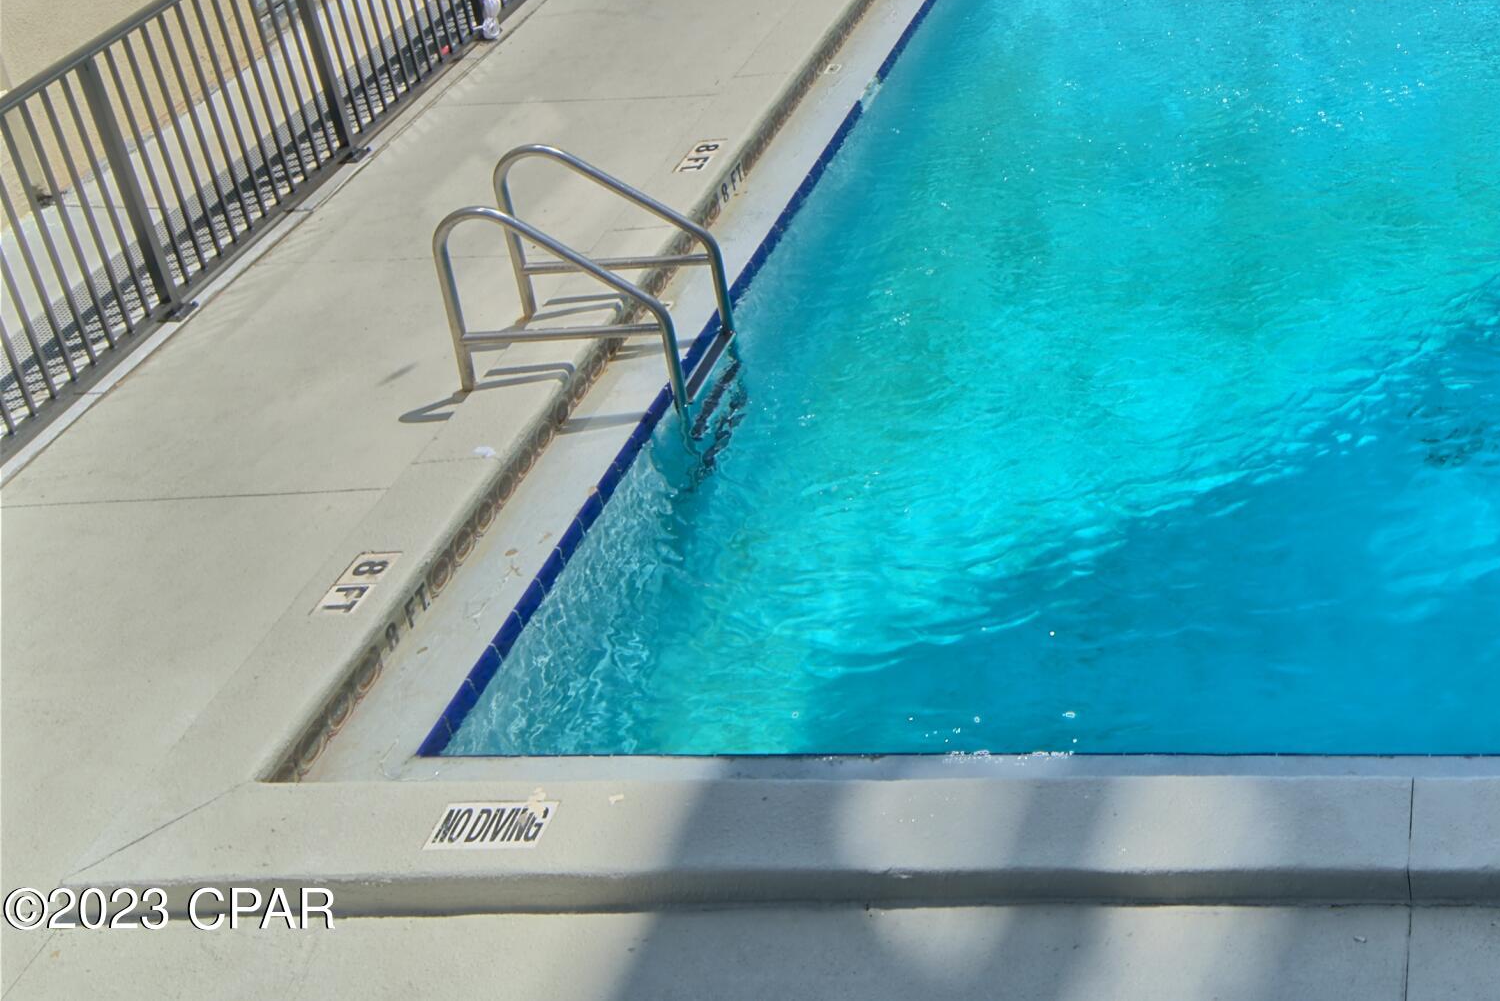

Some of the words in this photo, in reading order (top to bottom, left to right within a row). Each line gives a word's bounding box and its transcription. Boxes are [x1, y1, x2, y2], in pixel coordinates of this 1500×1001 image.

[695, 144, 719, 153] 8
[721, 182, 729, 203] 8
[352, 560, 390, 577] 8
[385, 622, 400, 652] 8
[431, 808, 473, 843] NO
[464, 807, 549, 843] DIVING
